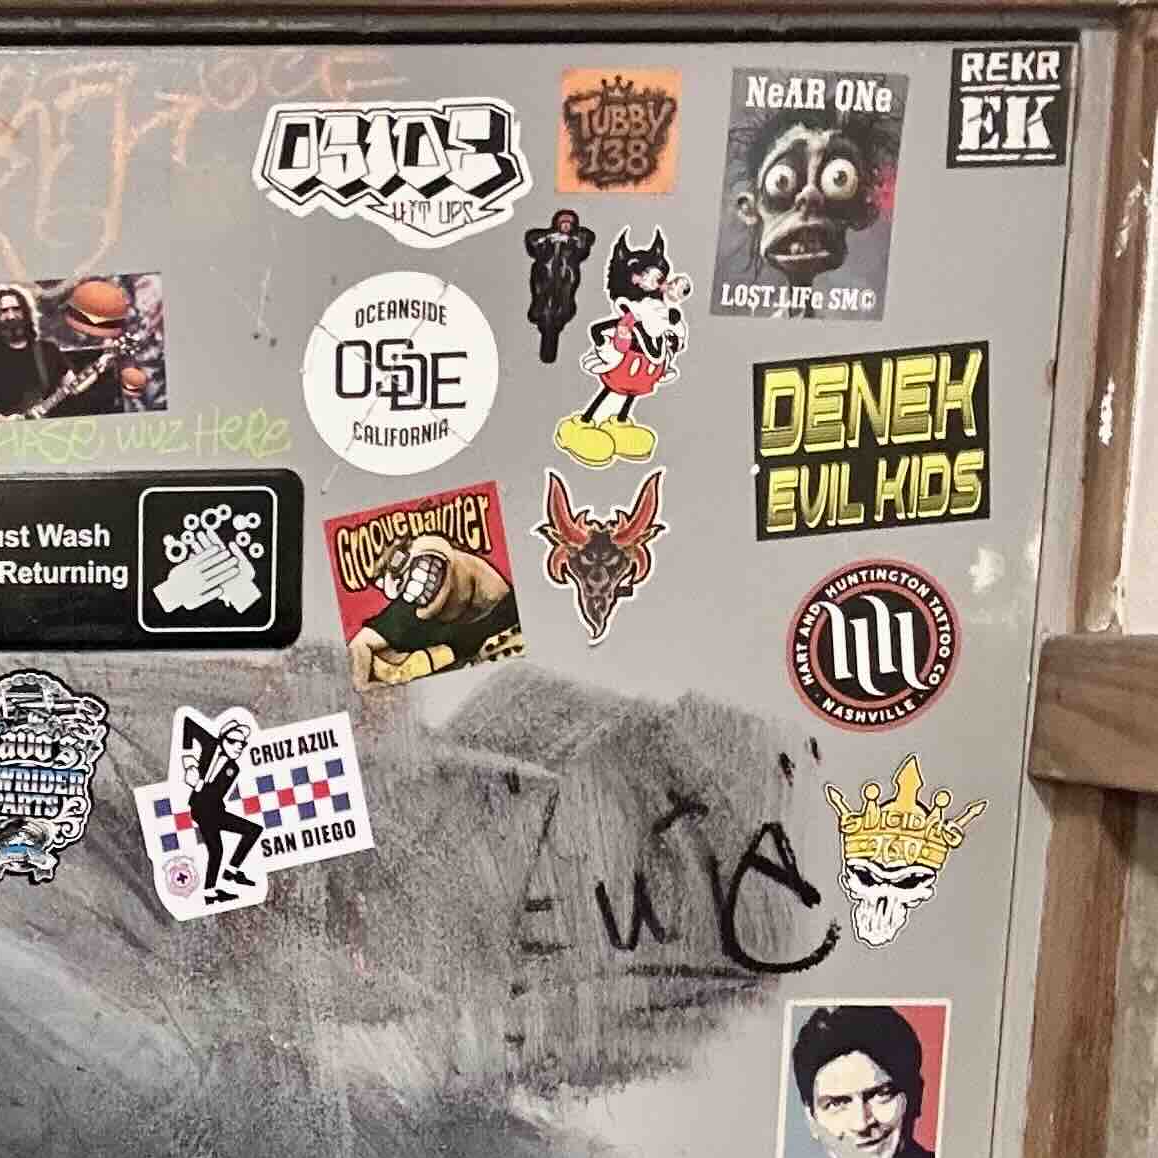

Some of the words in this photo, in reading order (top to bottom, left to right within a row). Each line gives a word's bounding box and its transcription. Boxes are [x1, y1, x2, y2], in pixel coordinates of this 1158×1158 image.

[961, 51, 1060, 82] REKR
[570, 97, 671, 143] TUBBY
[958, 96, 1055, 150] EK
[584, 138, 650, 176] 138
[354, 298, 448, 329] OCEANSIDE
[353, 418, 449, 447] CALIFORNIA
[766, 462, 865, 533] EVIL
[873, 448, 984, 522] KIDS
[36, 522, 111, 548] Wash
[824, 568, 931, 599] HUNTINGTON
[798, 603, 822, 638] AND
[927, 596, 952, 659] TATTOO
[795, 643, 816, 687] HART
[822, 697, 917, 723] NASHVILLE
[249, 741, 295, 767] CRUZ
[297, 729, 339, 756] AZUL
[260, 831, 298, 859] SAN
[301, 818, 357, 850] DIEGO
